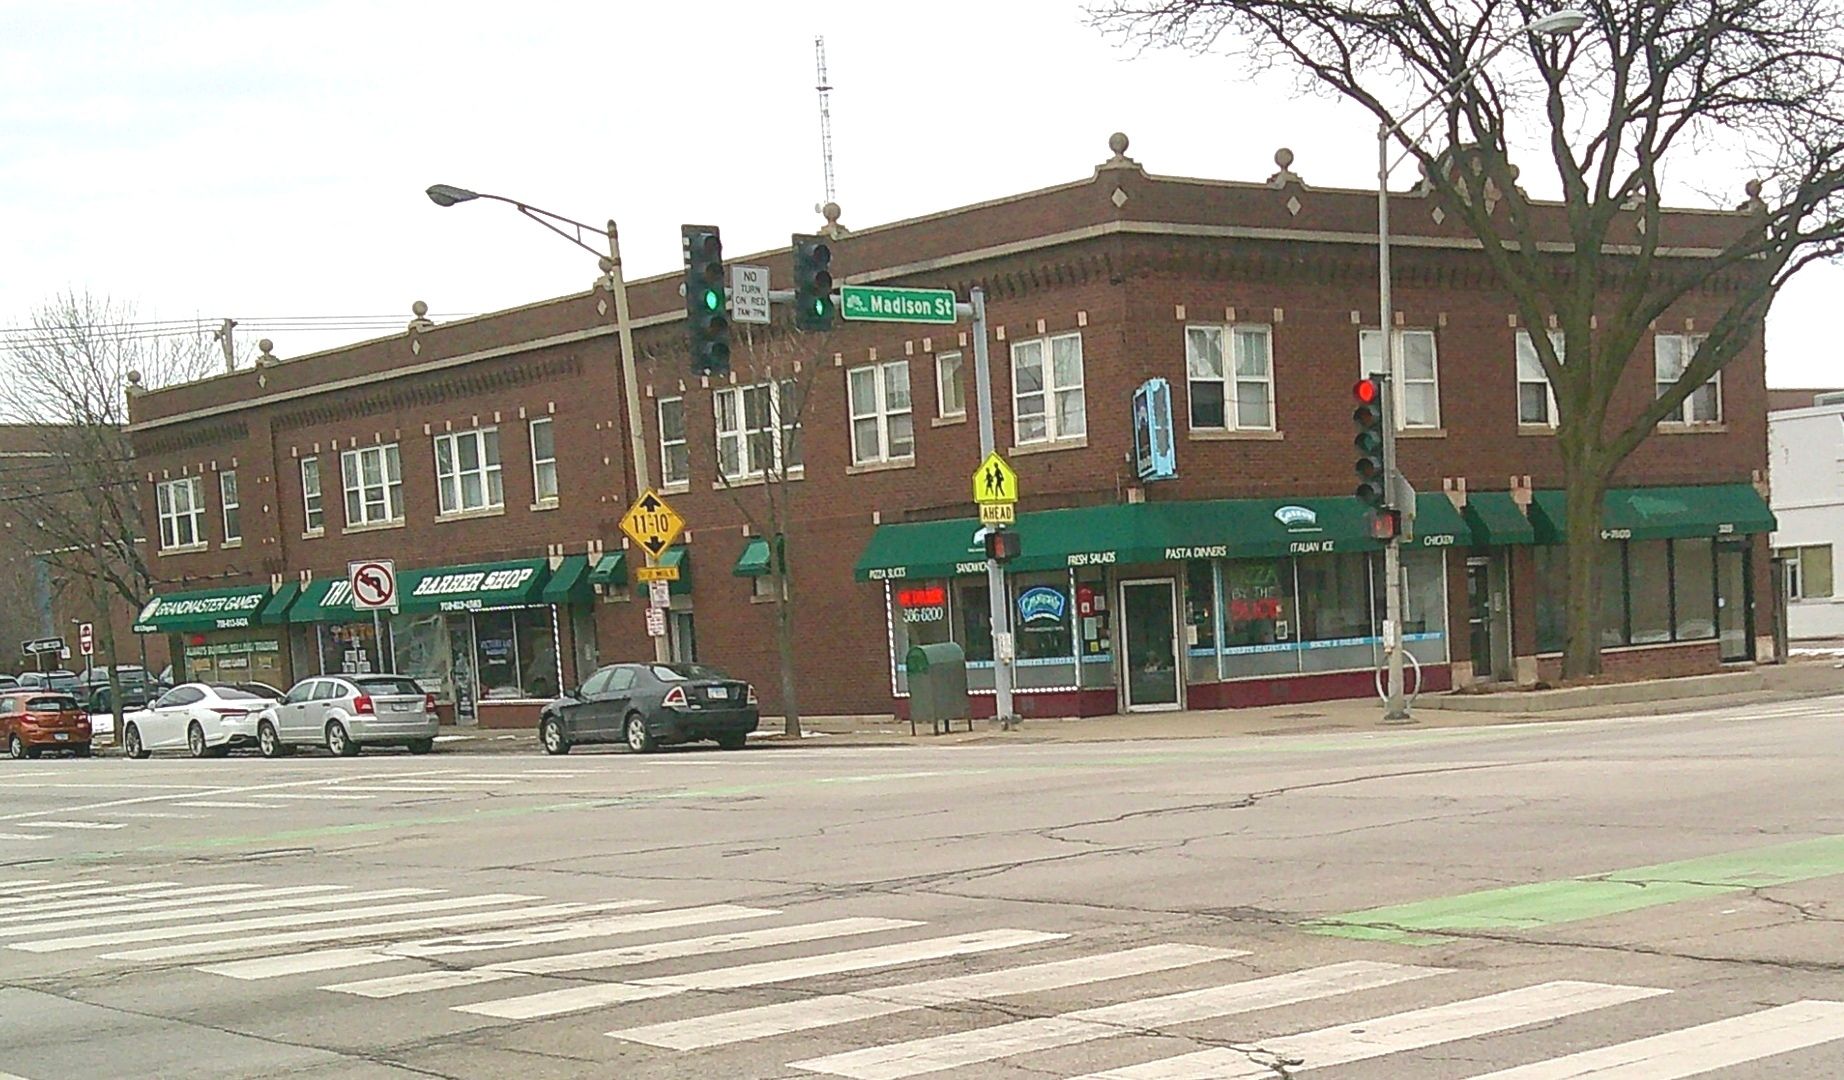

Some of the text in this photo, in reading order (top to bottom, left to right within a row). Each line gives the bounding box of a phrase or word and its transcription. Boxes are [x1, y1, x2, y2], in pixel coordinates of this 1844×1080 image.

[743, 271, 757, 282] NO
[741, 284, 761, 294] TURN
[735, 296, 767, 306] ON RED
[870, 294, 952, 316] Madison St
[983, 506, 1012, 520] AHEAD
[1165, 545, 1227, 560] PASTA DINNERS
[1290, 541, 1334, 553] ITALIAN ICE
[1067, 551, 1116, 566] FRESH SALADS
[869, 567, 906, 579] PIZZA SLICES
[955, 561, 988, 574] SANDWIC
[413, 568, 534, 596] BARBER SHOP
[155, 594, 263, 617] GRANDMASTER GAMES
